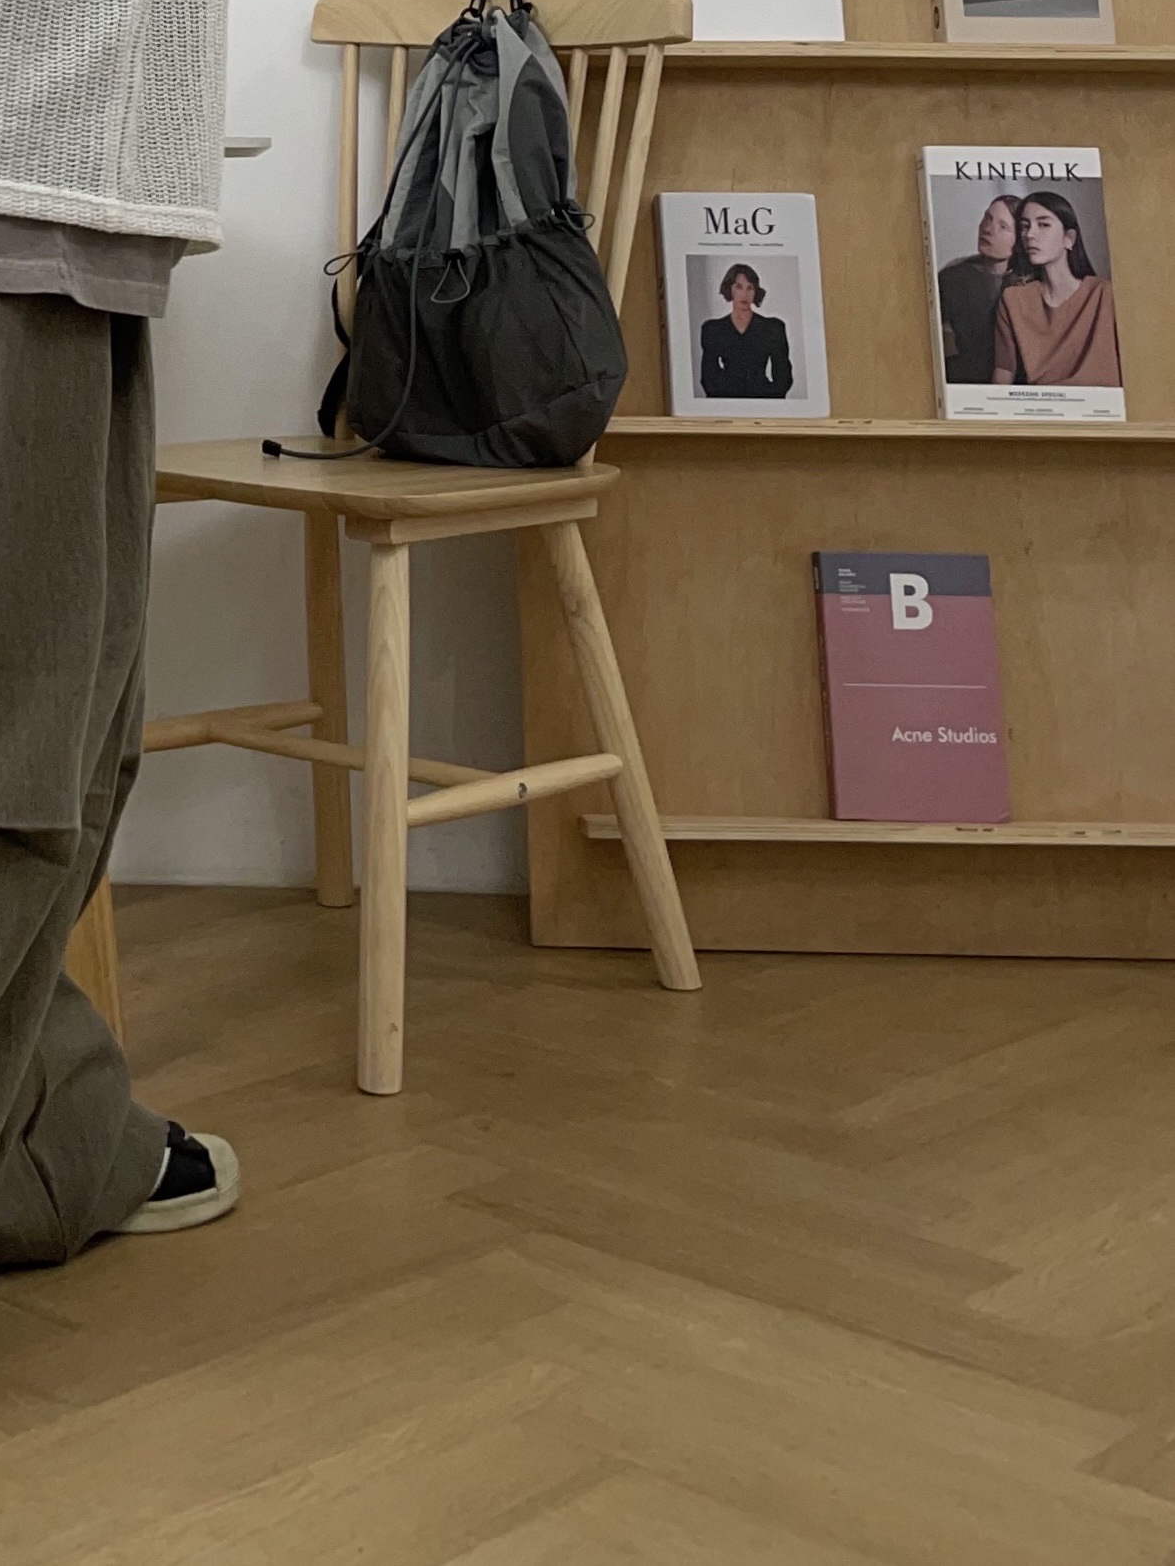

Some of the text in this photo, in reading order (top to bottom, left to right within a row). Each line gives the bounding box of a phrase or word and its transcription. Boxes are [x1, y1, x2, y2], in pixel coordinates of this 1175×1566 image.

[955, 161, 1083, 182] KINFOLK
[702, 206, 776, 235] MaG
[889, 572, 934, 630] B
[891, 726, 998, 744] Acne Studios
